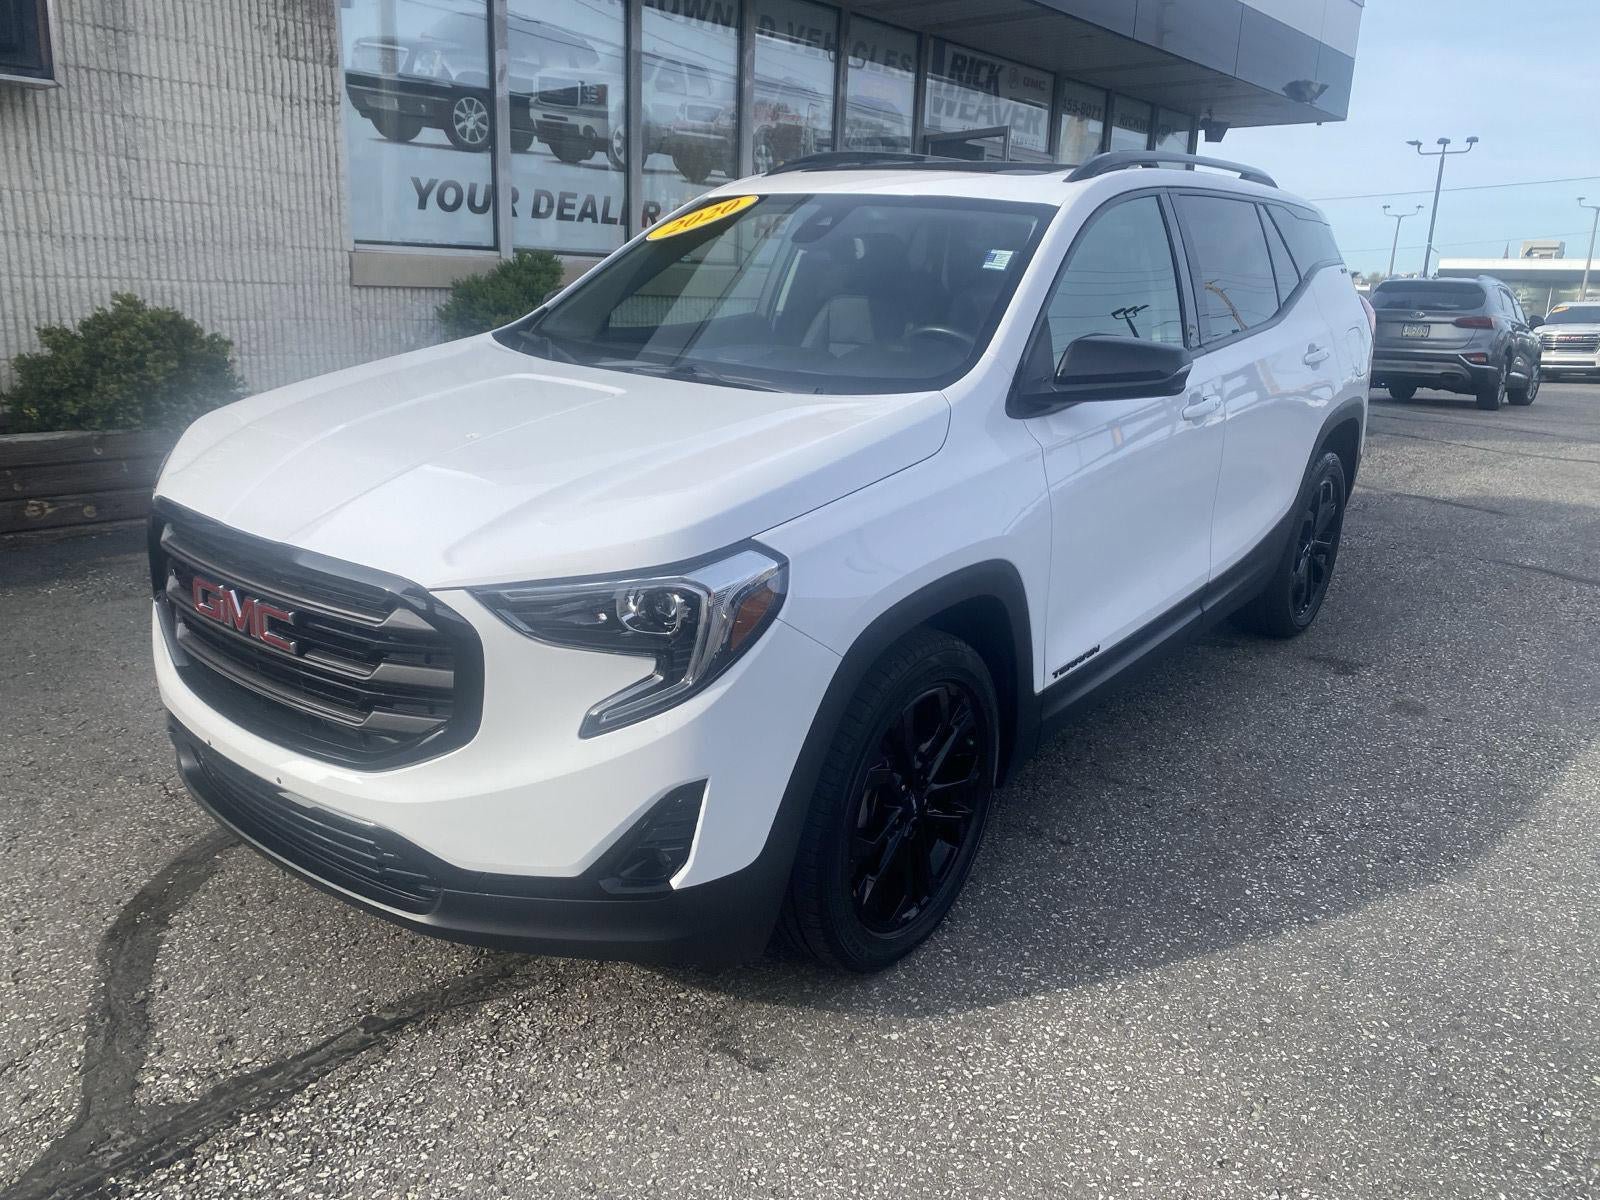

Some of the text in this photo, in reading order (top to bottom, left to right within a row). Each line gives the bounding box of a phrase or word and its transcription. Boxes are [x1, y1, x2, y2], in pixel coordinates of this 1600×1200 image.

[787, 21, 914, 73] VEHCLES
[948, 53, 1003, 96] RICK
[931, 89, 1043, 135] WEAVER
[531, 188, 660, 228] DEALR
[663, 199, 740, 236] 2020
[192, 577, 297, 654] GMC
